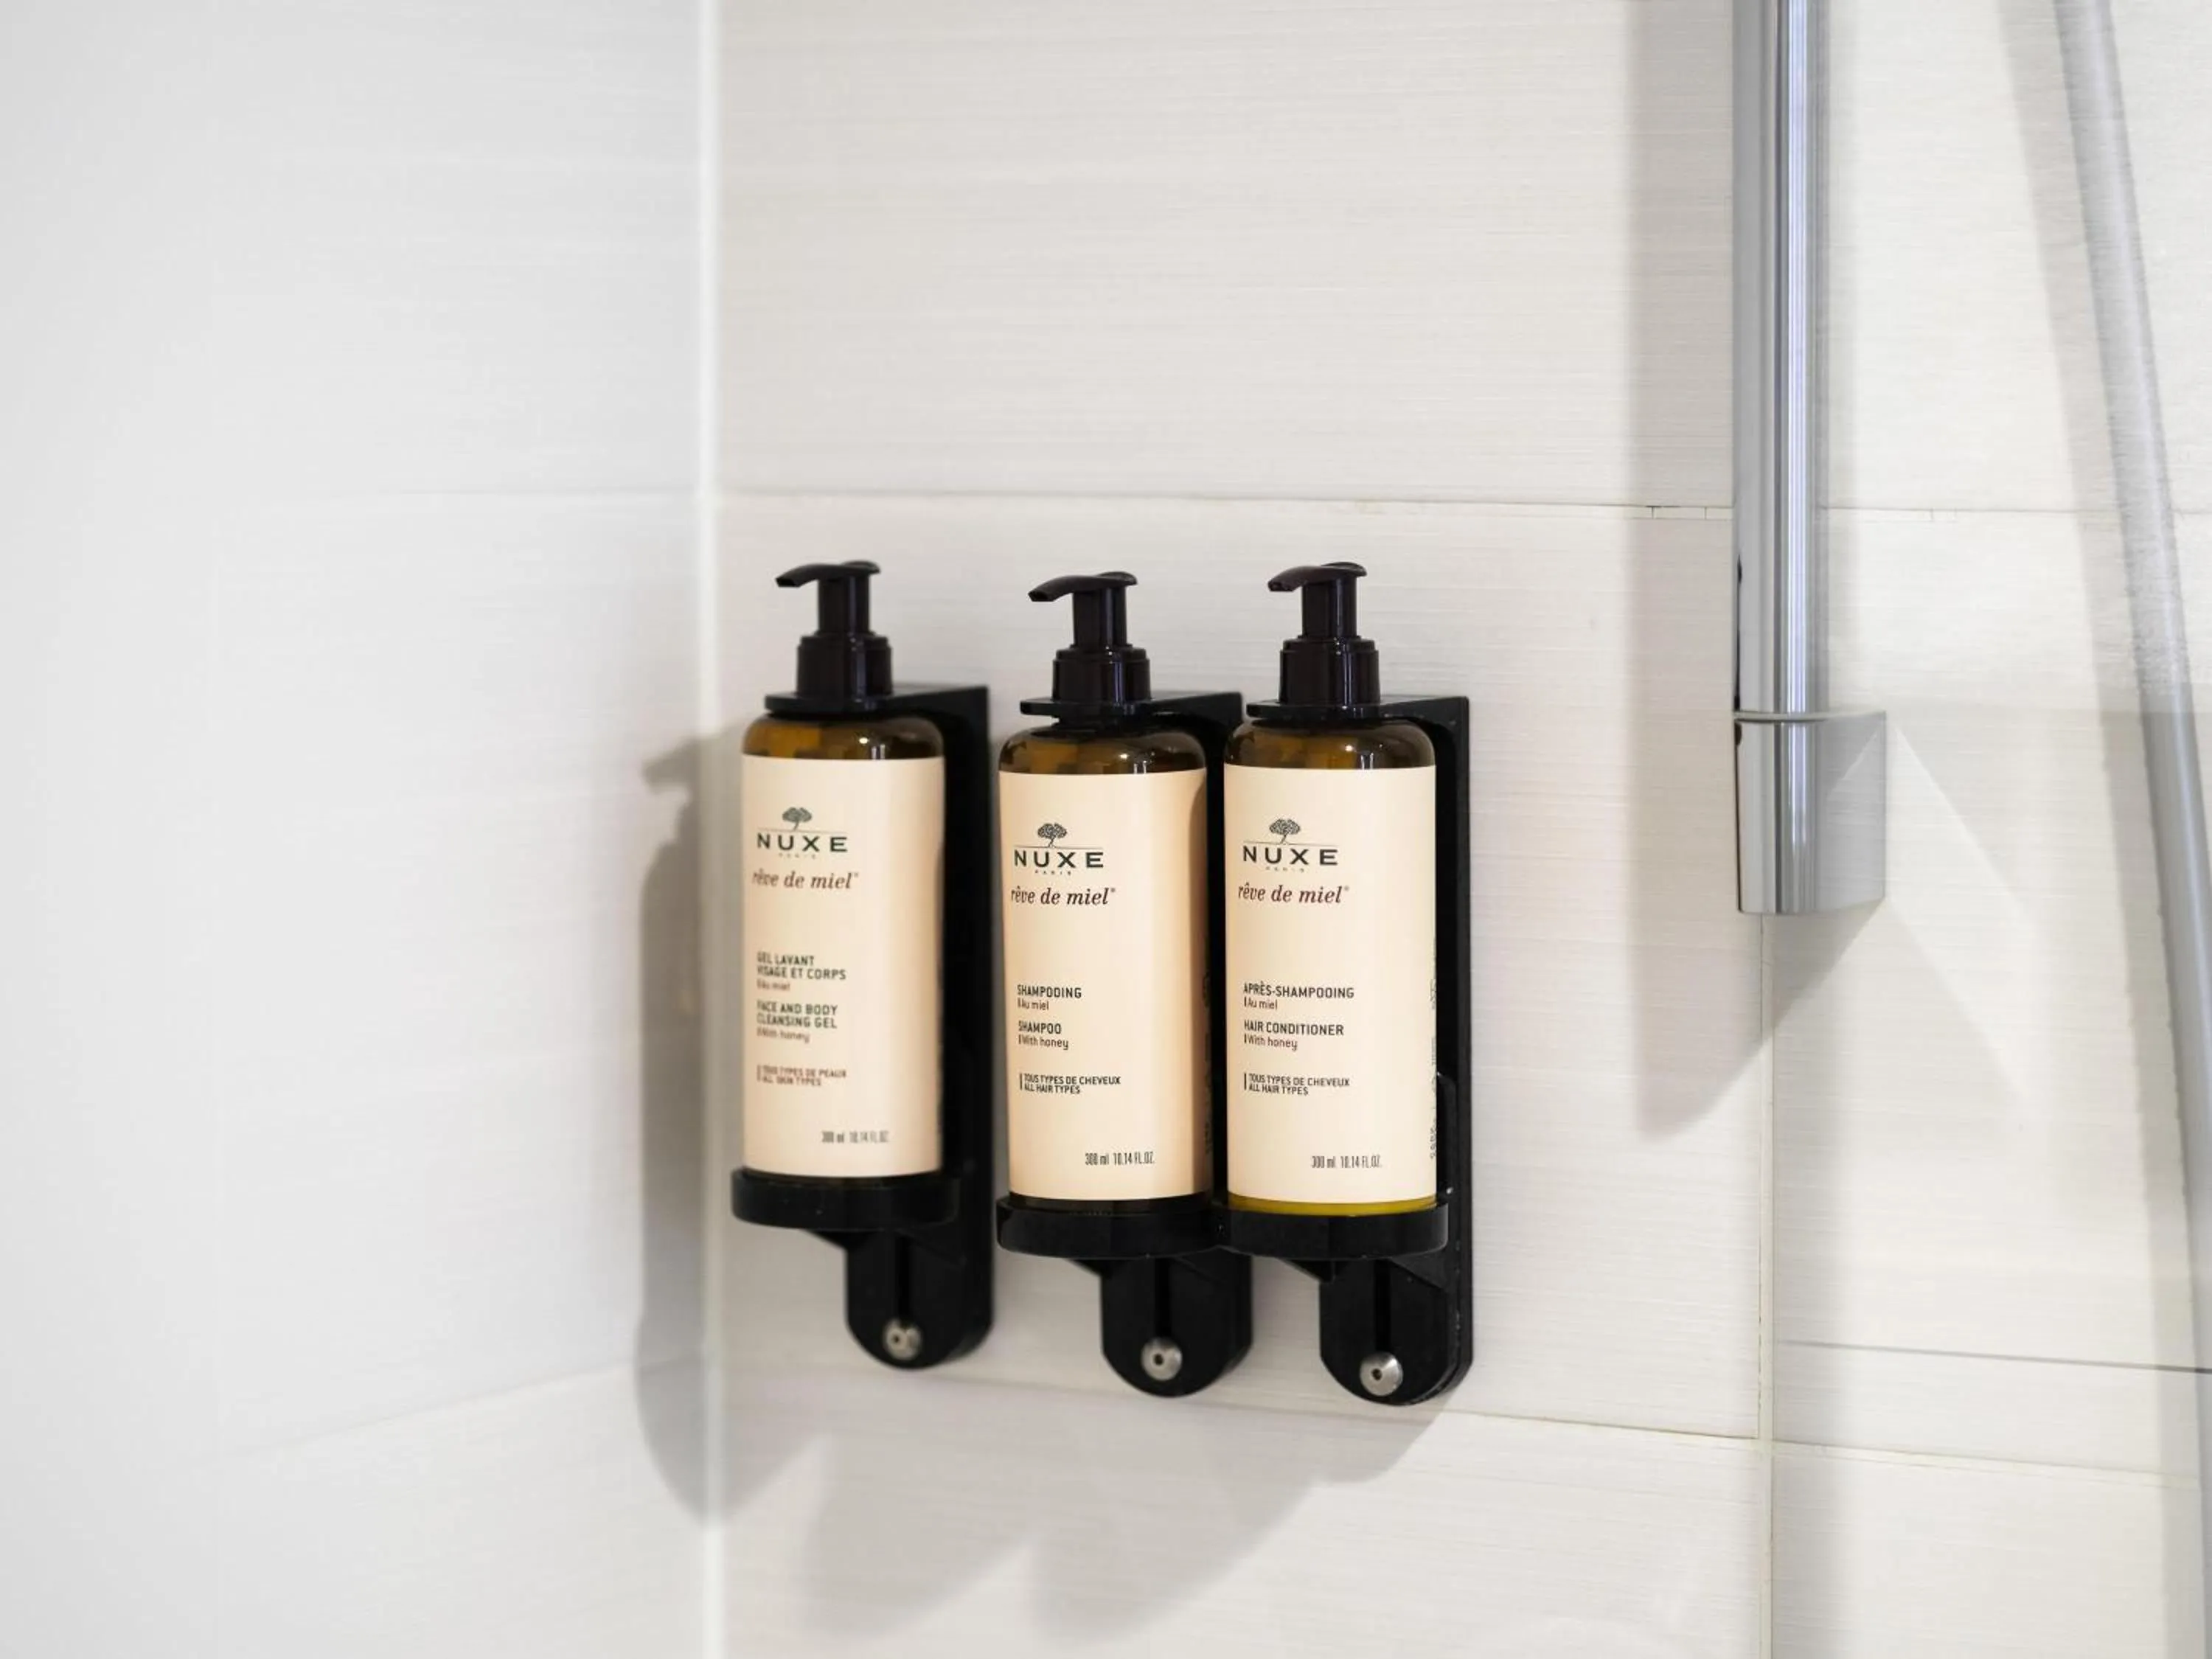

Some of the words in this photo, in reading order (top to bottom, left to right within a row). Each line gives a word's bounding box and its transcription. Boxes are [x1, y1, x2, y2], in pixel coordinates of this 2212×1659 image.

[757, 832, 847, 852] NUXE
[1015, 849, 1104, 869] NUXE
[1243, 846, 1338, 866] NUXE
[751, 867, 779, 886] rêve
[784, 871, 804, 888] de
[1011, 886, 1035, 902] rêve
[1040, 888, 1060, 905] de
[1238, 882, 1266, 901] rêve
[1270, 885, 1292, 902] de
[774, 953, 815, 966] LAVANT
[790, 967, 804, 978] ET
[807, 968, 846, 980] CORPS
[1017, 984, 1082, 998] SHAMPOOING
[1243, 981, 1354, 999] APRÈS-SHAMPOOING
[780, 1003, 802, 1014] AND
[805, 1004, 838, 1015] BODY
[1032, 1000, 1049, 1010] miel
[1259, 999, 1278, 1010] miel
[757, 1012, 811, 1027] CLEANSING
[814, 1016, 838, 1029] GEL
[1018, 1020, 1062, 1034] SHAMPOO
[1244, 1019, 1263, 1032] HAIR
[1266, 1021, 1344, 1036] CONDITIONER
[1040, 1037, 1069, 1051] honey
[1248, 1034, 1266, 1046] With
[1267, 1036, 1298, 1051] honey
[1041, 1074, 1064, 1085] TYPES
[1065, 1076, 1077, 1085] DE
[1079, 1076, 1121, 1085] CHEVEUX
[1267, 1074, 1291, 1085] TYPES
[1293, 1077, 1305, 1086] DE
[1307, 1077, 1350, 1087] CHEVEUX
[1025, 1083, 1034, 1092] ALL
[1036, 1084, 1054, 1093] HAIR
[1055, 1085, 1080, 1094] TYPES
[1249, 1084, 1259, 1092] ALL
[1262, 1085, 1280, 1094] HAIR
[1282, 1086, 1309, 1096] TYPES
